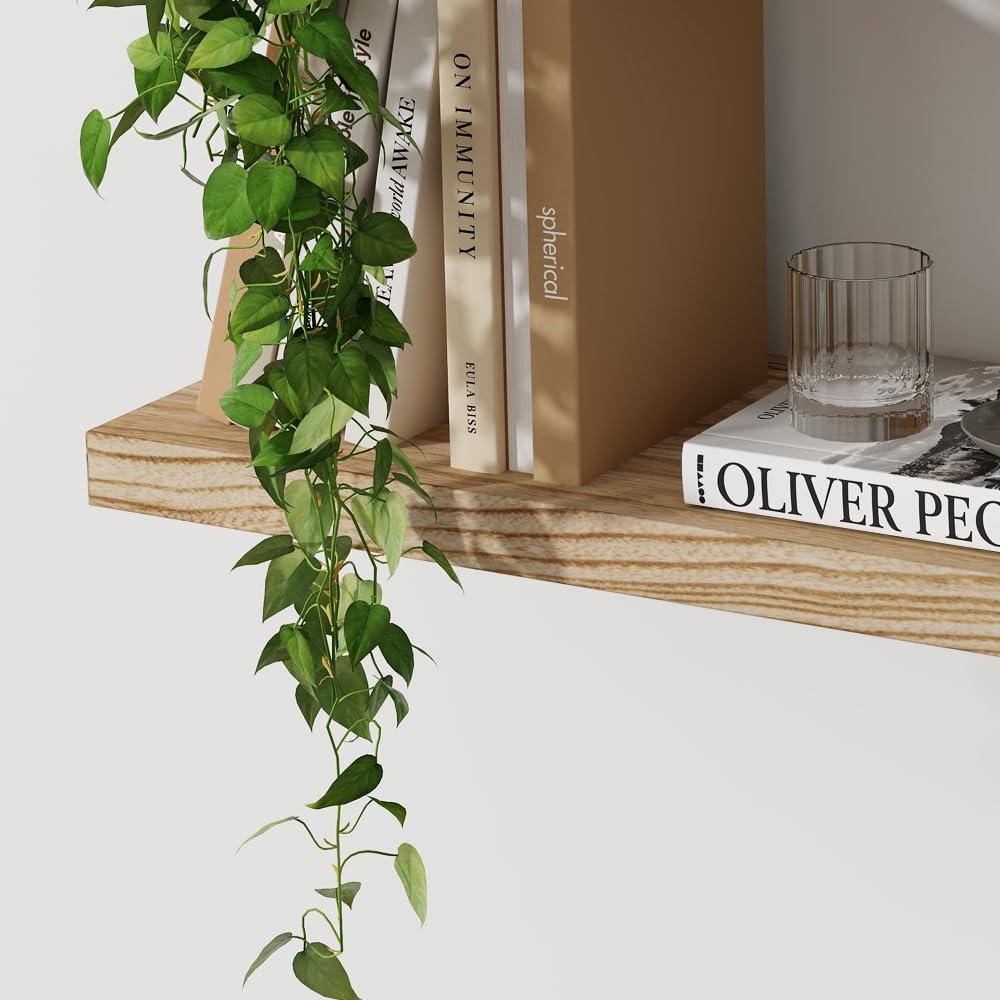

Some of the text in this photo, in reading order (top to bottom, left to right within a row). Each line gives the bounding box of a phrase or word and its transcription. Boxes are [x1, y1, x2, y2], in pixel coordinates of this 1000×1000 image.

[354, 29, 371, 64] yle
[391, 96, 415, 180] AWAKE
[453, 53, 477, 260] ON IMMUNITY
[535, 206, 569, 300] spherical
[465, 361, 477, 434] EULA BISS
[757, 398, 789, 420] OLIV
[717, 461, 902, 533] OLIVER
